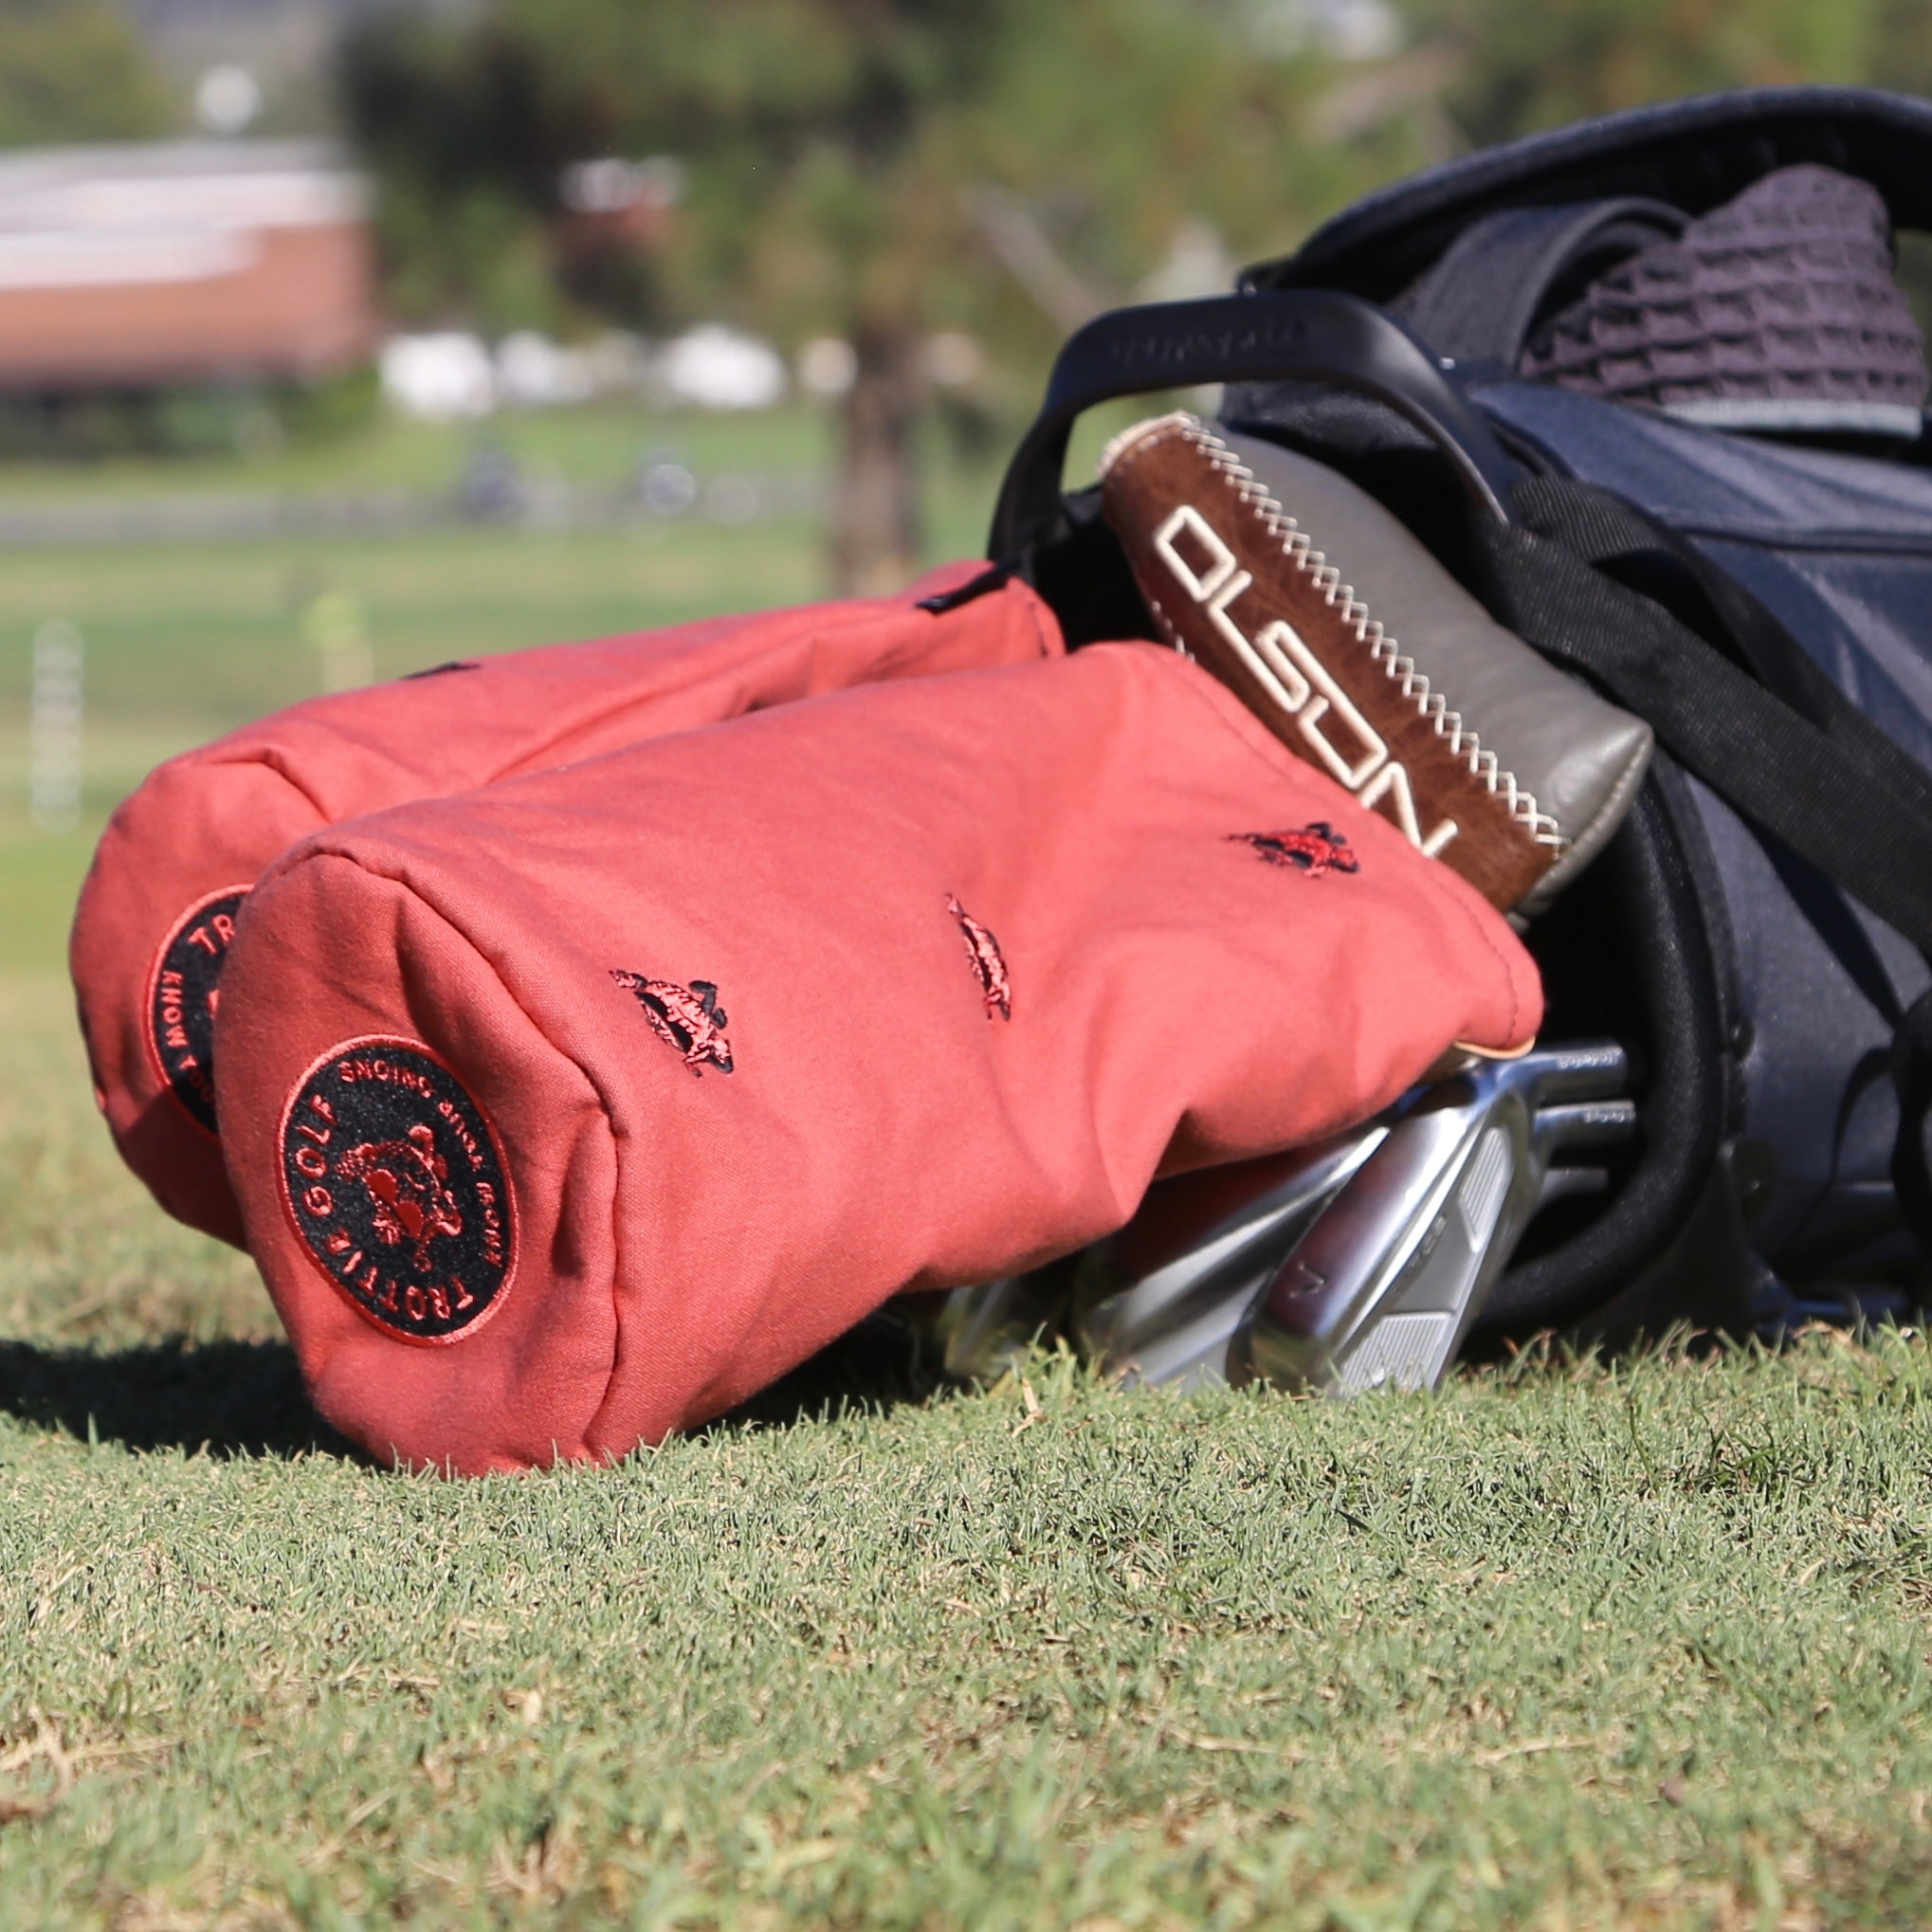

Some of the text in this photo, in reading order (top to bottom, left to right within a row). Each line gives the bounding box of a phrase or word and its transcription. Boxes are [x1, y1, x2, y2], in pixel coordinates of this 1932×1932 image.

[1155, 504, 1459, 857] OLSON
[161, 970, 215, 1105] KNOW YOU
[187, 913, 237, 957] TR
[294, 1093, 476, 1320] TROTTIE GOLF
[337, 1059, 502, 1267] KNOW YOUR ONIONS
